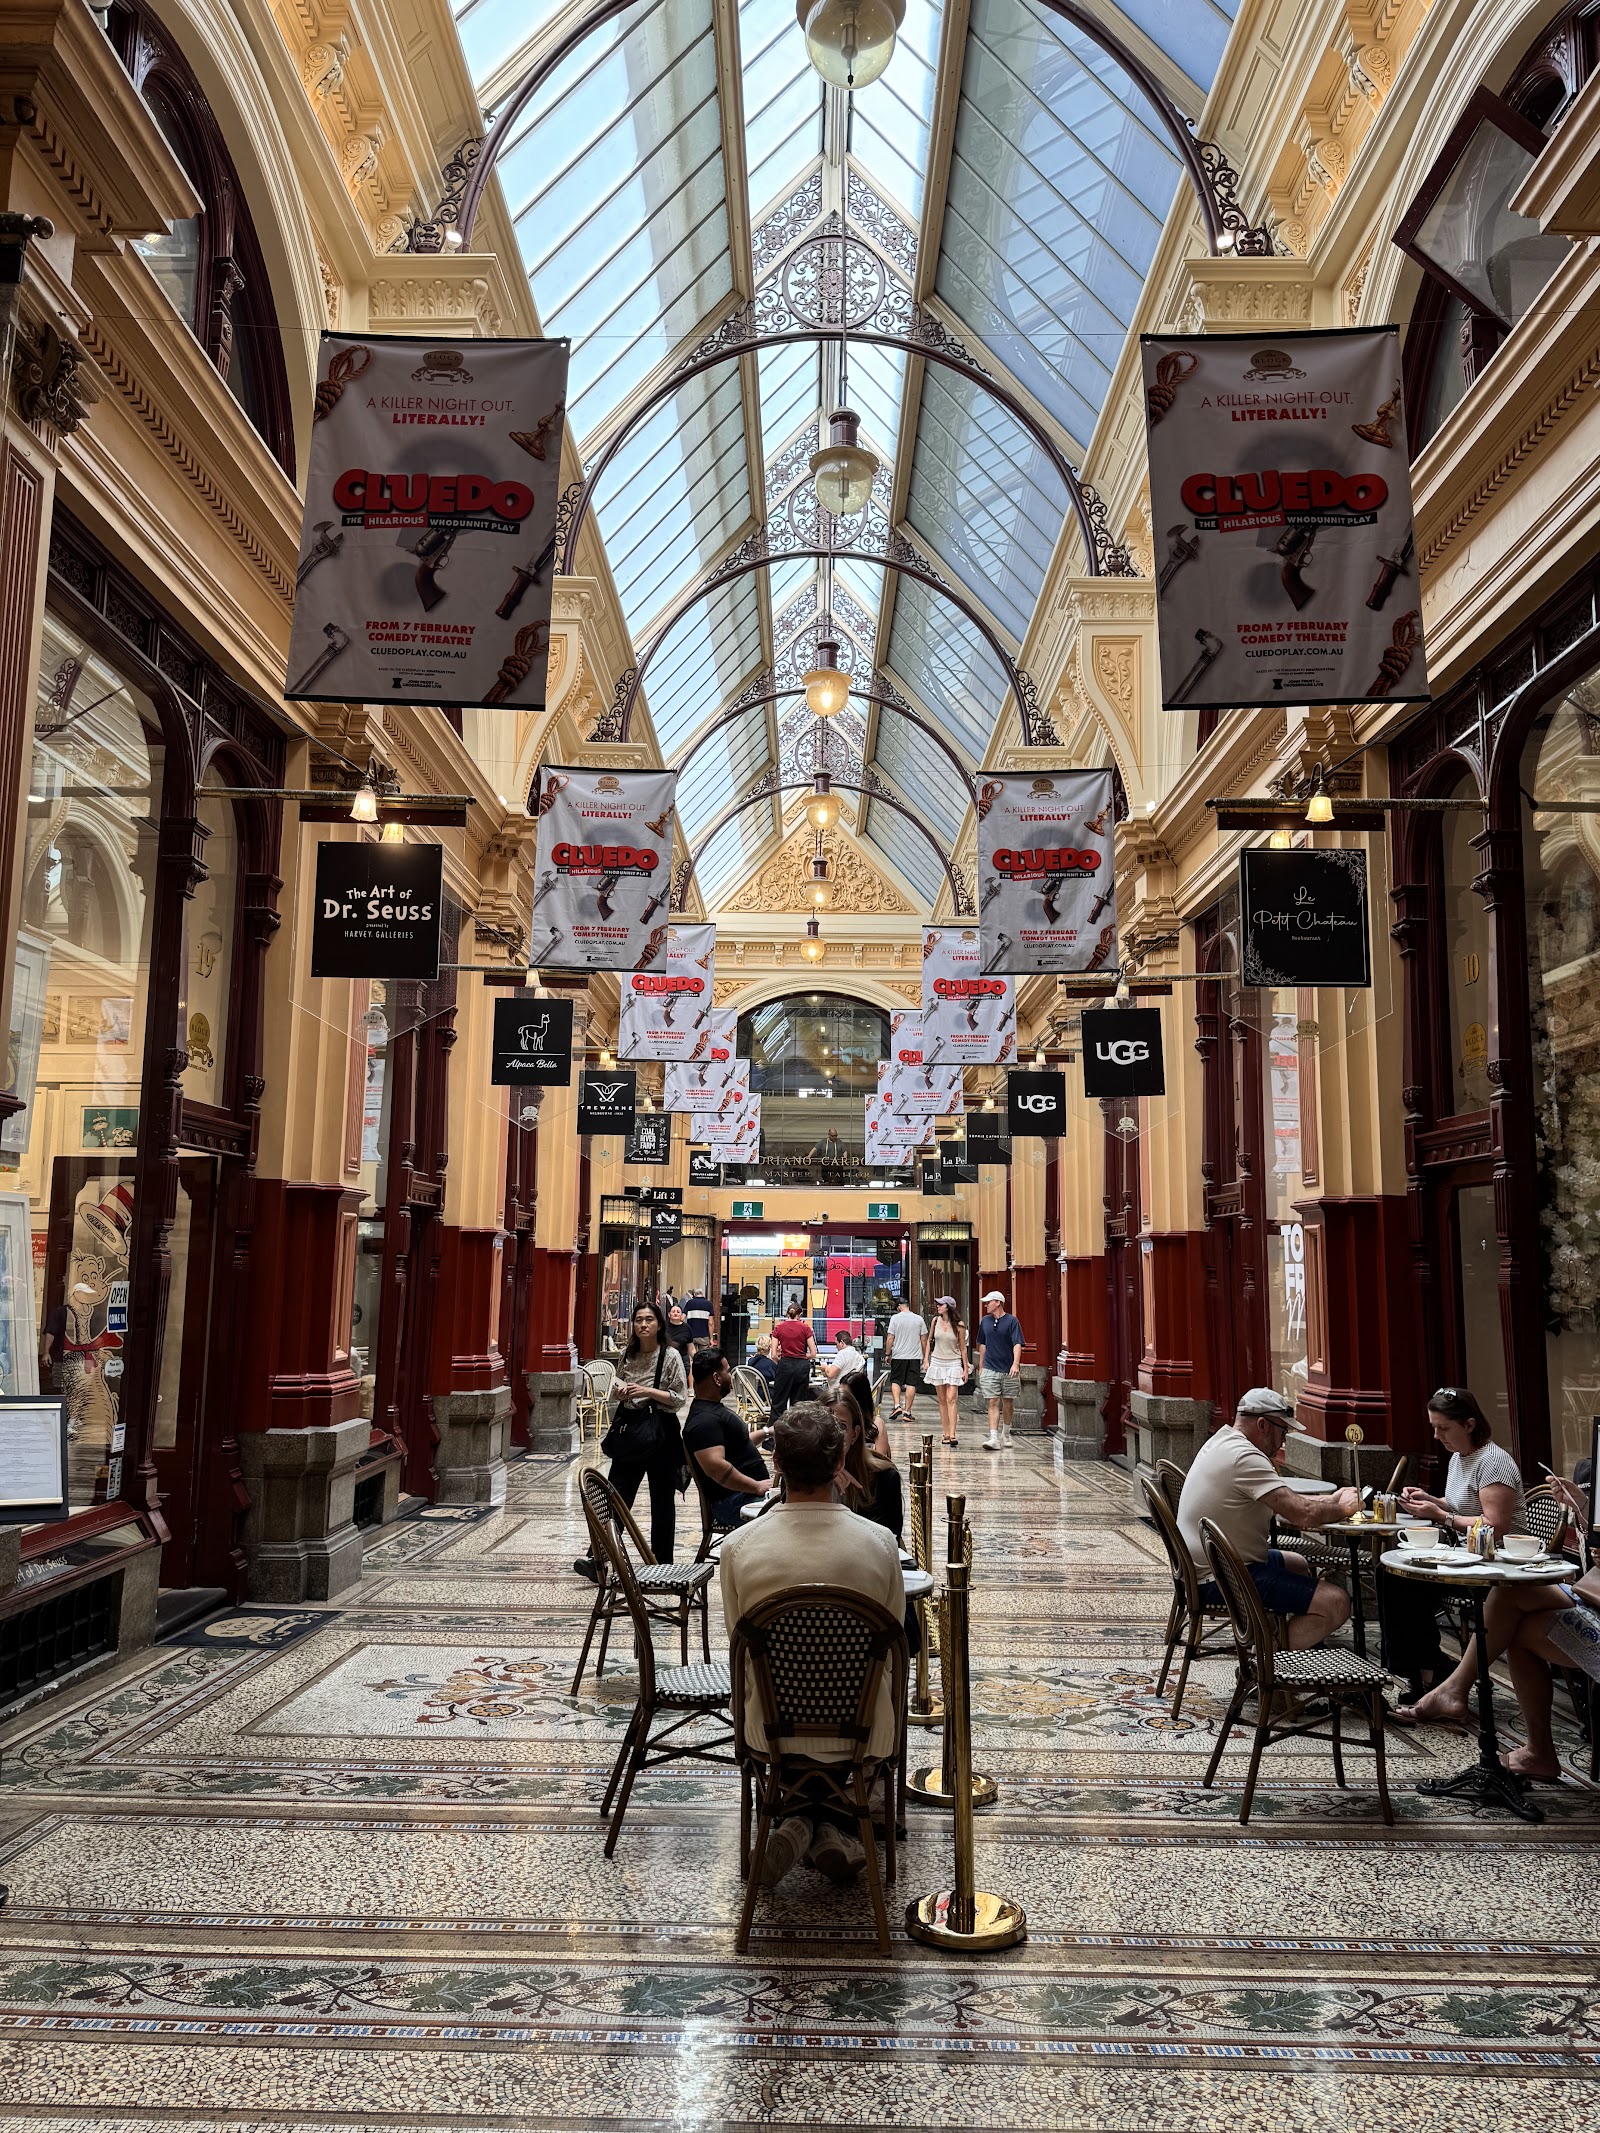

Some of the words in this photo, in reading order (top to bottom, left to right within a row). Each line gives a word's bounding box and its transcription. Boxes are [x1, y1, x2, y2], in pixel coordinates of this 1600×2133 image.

[366, 397, 377, 407] A
[382, 397, 423, 410] KILLER
[429, 399, 477, 411] NIGHT
[482, 400, 514, 412] OUT.
[1201, 398, 1212, 408] A
[1216, 394, 1258, 407] KILLER
[1266, 392, 1314, 406] NIGHT
[1320, 392, 1354, 404] OUT.
[392, 413, 485, 426] LITERALLY!
[1232, 408, 1327, 422] LITERALLY!
[334, 468, 534, 520] CLUEDO
[1181, 470, 1388, 515] CLUEDO
[346, 517, 362, 525] THE
[368, 516, 424, 526] HILARIOUS
[429, 518, 489, 529] WHODUNNIT
[491, 522, 515, 532] PLAY
[1199, 519, 1216, 528] THE
[1223, 515, 1282, 529] HILARIOUS
[1287, 516, 1346, 525] WHODUNNIT
[1348, 515, 1371, 525] PLAY
[366, 620, 400, 632] FROM
[403, 622, 411, 632] 7
[414, 622, 476, 635] FEBRUARY
[1237, 622, 1272, 633] FROM
[1276, 622, 1285, 632] 7
[1287, 622, 1348, 632] FEBRUARY
[368, 632, 418, 644] COMEDY
[421, 634, 472, 646] THEATRE
[1241, 633, 1292, 644] COMEDY
[1296, 633, 1346, 642] THEATRE
[370, 647, 467, 659] CLUEDOPLAY.COM.AU
[1246, 647, 1344, 658] CLUEDOPLAY.COM.AU
[581, 811, 632, 819] LITERALLY!
[1038, 805, 1064, 813] NIGHT
[1020, 814, 1070, 822] LITERALLY!
[551, 842, 659, 870] CLUEDO
[993, 848, 1101, 872] CLUEDO
[346, 888, 367, 899] The
[370, 885, 395, 899] Art
[400, 889, 412, 899] of
[323, 899, 357, 918] Dr.
[367, 900, 432, 920] Seuss
[1253, 910, 1297, 931] Petit
[1297, 910, 1358, 931] Chateau
[344, 930, 372, 938] HARVEY
[376, 931, 414, 939] GALLERIES
[1464, 953, 1480, 986] 10
[632, 974, 704, 992] CLUEDO
[933, 978, 1007, 995] CLUEDO
[1466, 1034, 1484, 1046] BLOCK
[898, 1049, 923, 1062] CLU
[1096, 1040, 1150, 1065] UGG
[506, 1059, 535, 1070] Alpaca
[536, 1060, 558, 1068] Bella
[1018, 1094, 1056, 1113] UGG
[821, 1156, 866, 1166] CARBO
[653, 1191, 668, 1200] Lift
[670, 1192, 675, 1200] 3
[1281, 1223, 1304, 1262] TO
[111, 1288, 127, 1304] OPEN
[109, 1314, 120, 1324] COME
[121, 1313, 126, 1323] IN
[1350, 1428, 1359, 1440] 76
